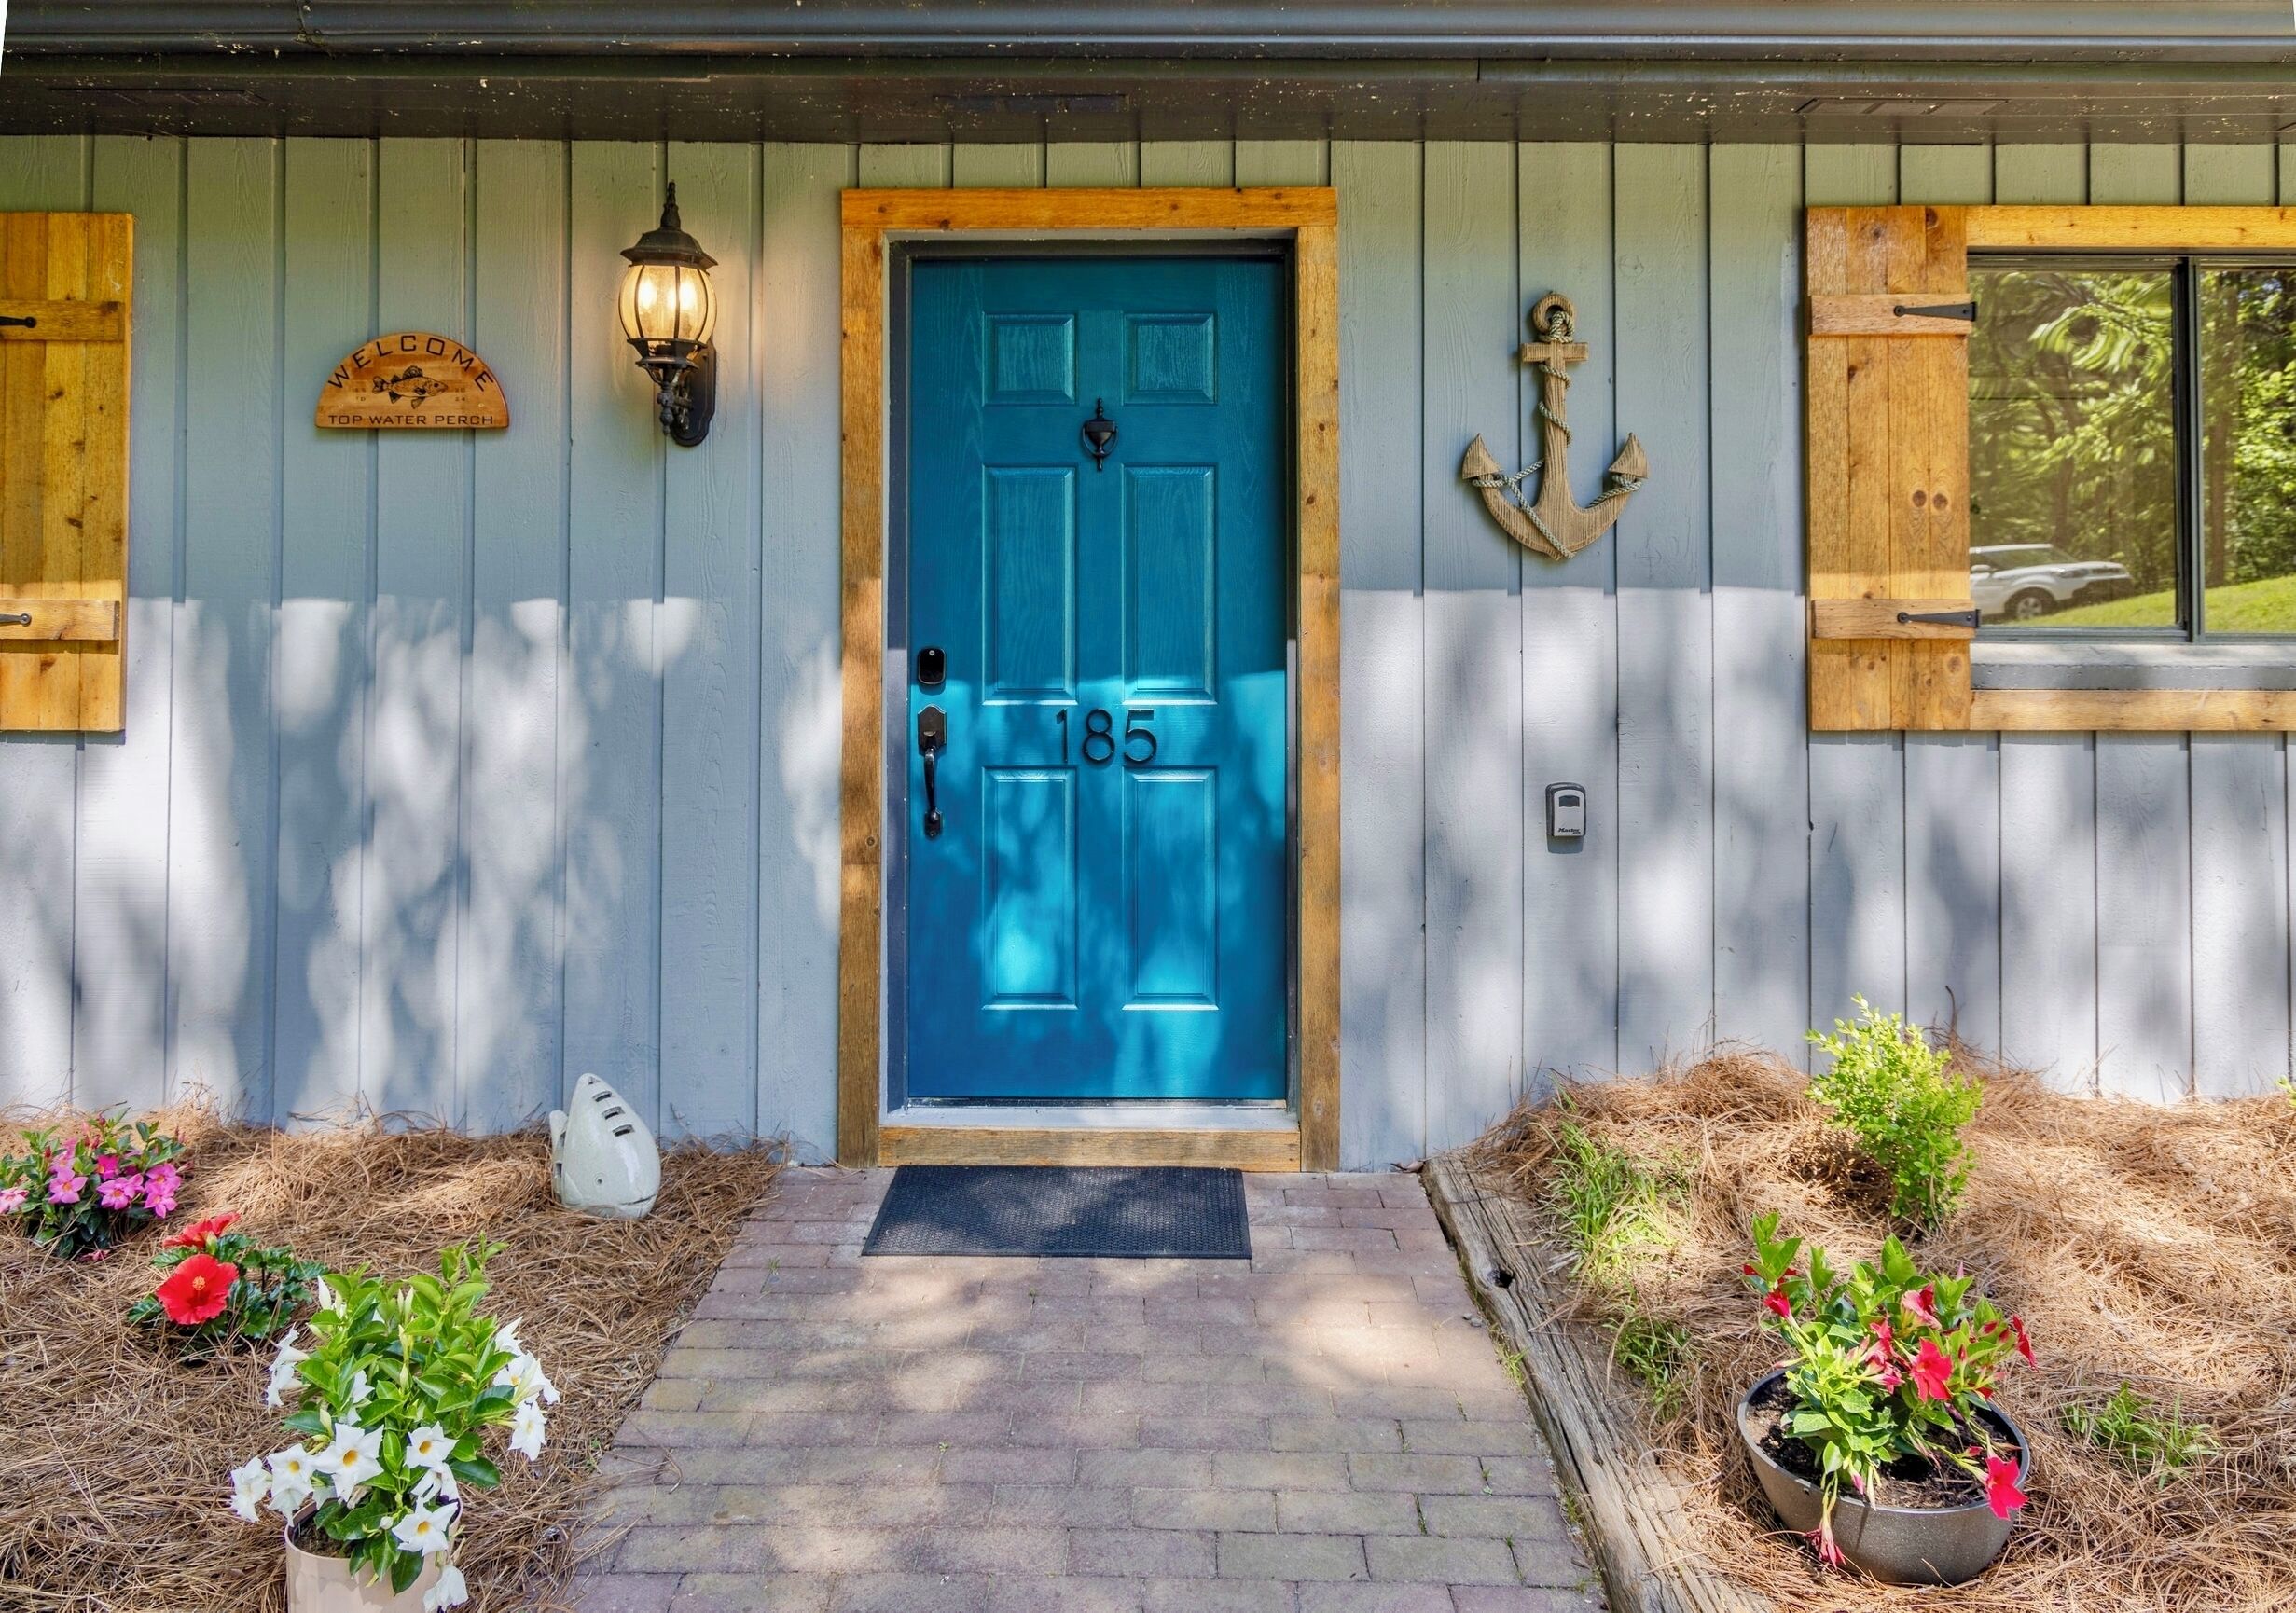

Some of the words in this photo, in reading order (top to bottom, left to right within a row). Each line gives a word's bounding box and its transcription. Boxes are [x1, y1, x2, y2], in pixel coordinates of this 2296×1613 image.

[328, 335, 493, 392] WELCOME
[328, 415, 362, 425] TOP
[369, 415, 426, 425] WATER
[435, 415, 493, 425] PERCH
[1056, 708, 1158, 765] 185
